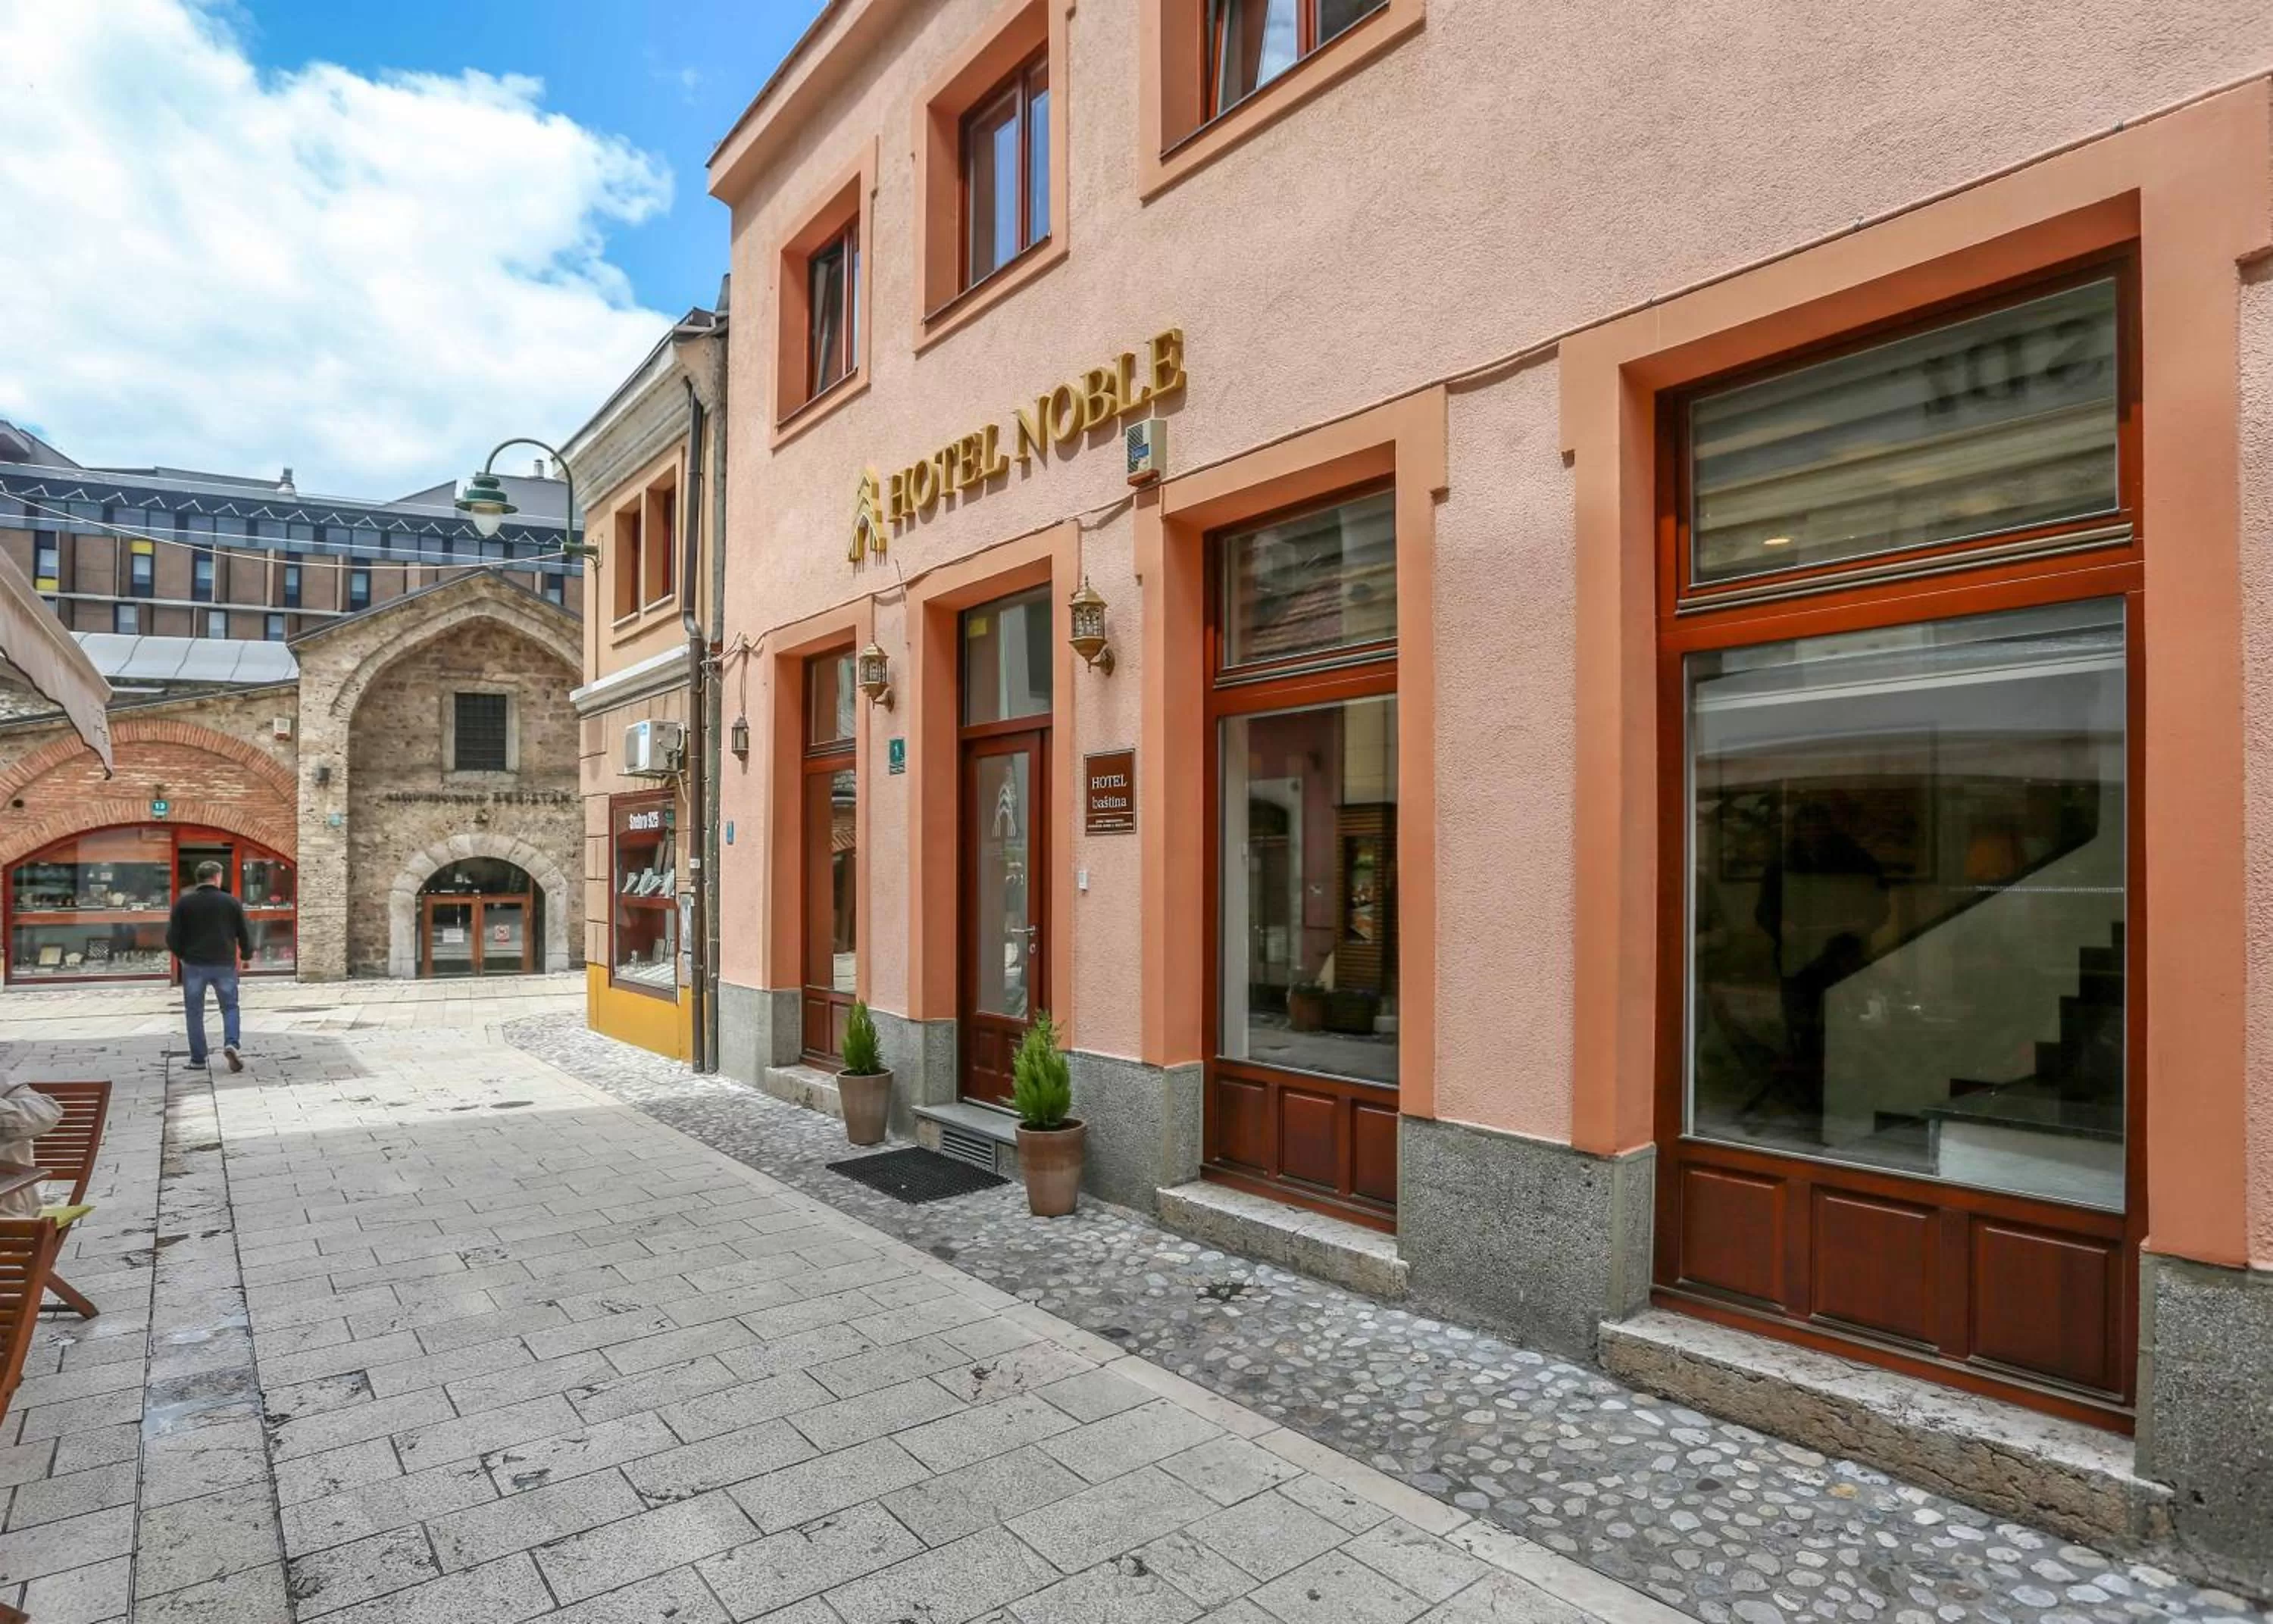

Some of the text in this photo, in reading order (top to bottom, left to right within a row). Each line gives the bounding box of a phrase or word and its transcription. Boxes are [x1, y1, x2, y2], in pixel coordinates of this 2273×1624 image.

[887, 327, 1187, 523] HOTEL NOBLE
[1092, 774, 1127, 789] HOTEL
[1092, 795, 1127, 809] baština
[648, 810, 659, 828] 925
